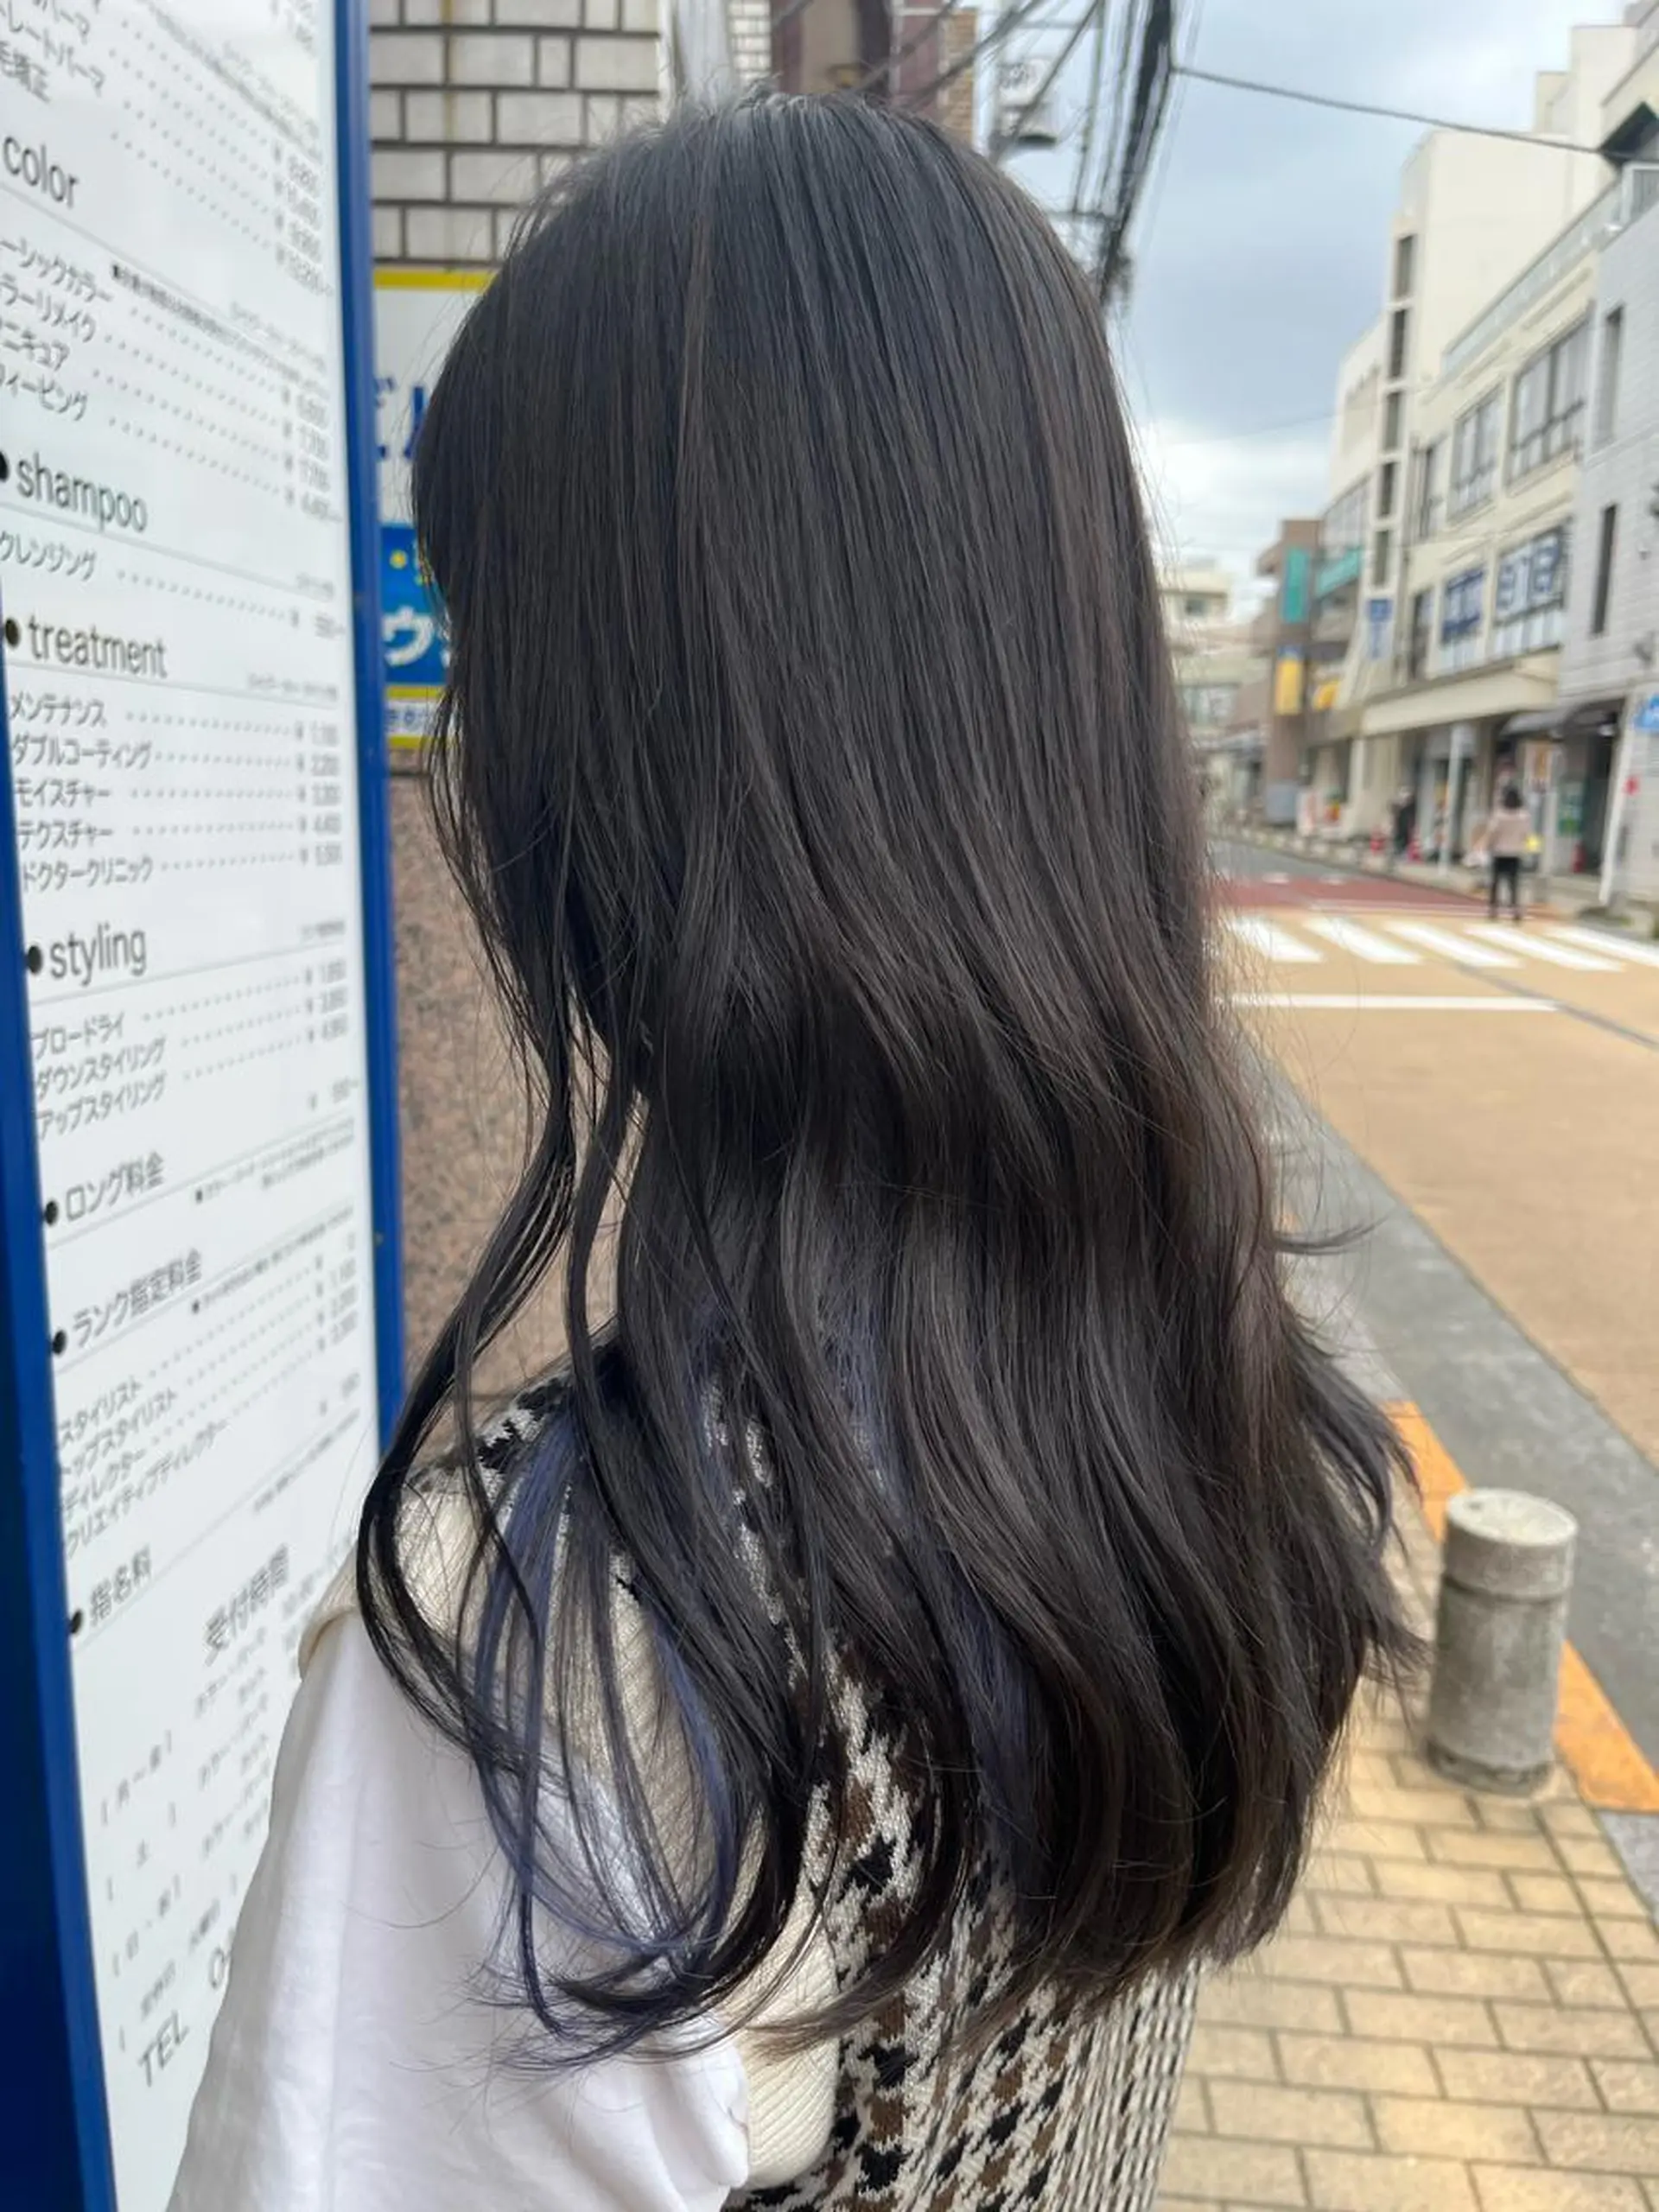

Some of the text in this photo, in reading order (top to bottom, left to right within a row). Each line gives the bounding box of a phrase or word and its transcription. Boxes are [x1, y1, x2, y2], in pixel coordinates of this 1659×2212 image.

[3, 137, 78, 208] color
[16, 452, 148, 531] shampoo
[29, 613, 168, 678] treatment
[11, 690, 107, 728] メンテナンス
[12, 734, 152, 770] ダブルコーティング
[16, 777, 111, 808] モイスチャー
[17, 819, 113, 851] テクスチャー
[22, 855, 154, 893] ドクタークリニック
[49, 922, 147, 987] styling
[31, 1011, 125, 1060] ブロードライ
[36, 1034, 167, 1101] ダウンスタイリング
[38, 1071, 167, 1141] アップスタイリング
[66, 1151, 164, 1222] ロング料金
[137, 2011, 189, 2088] TEL
